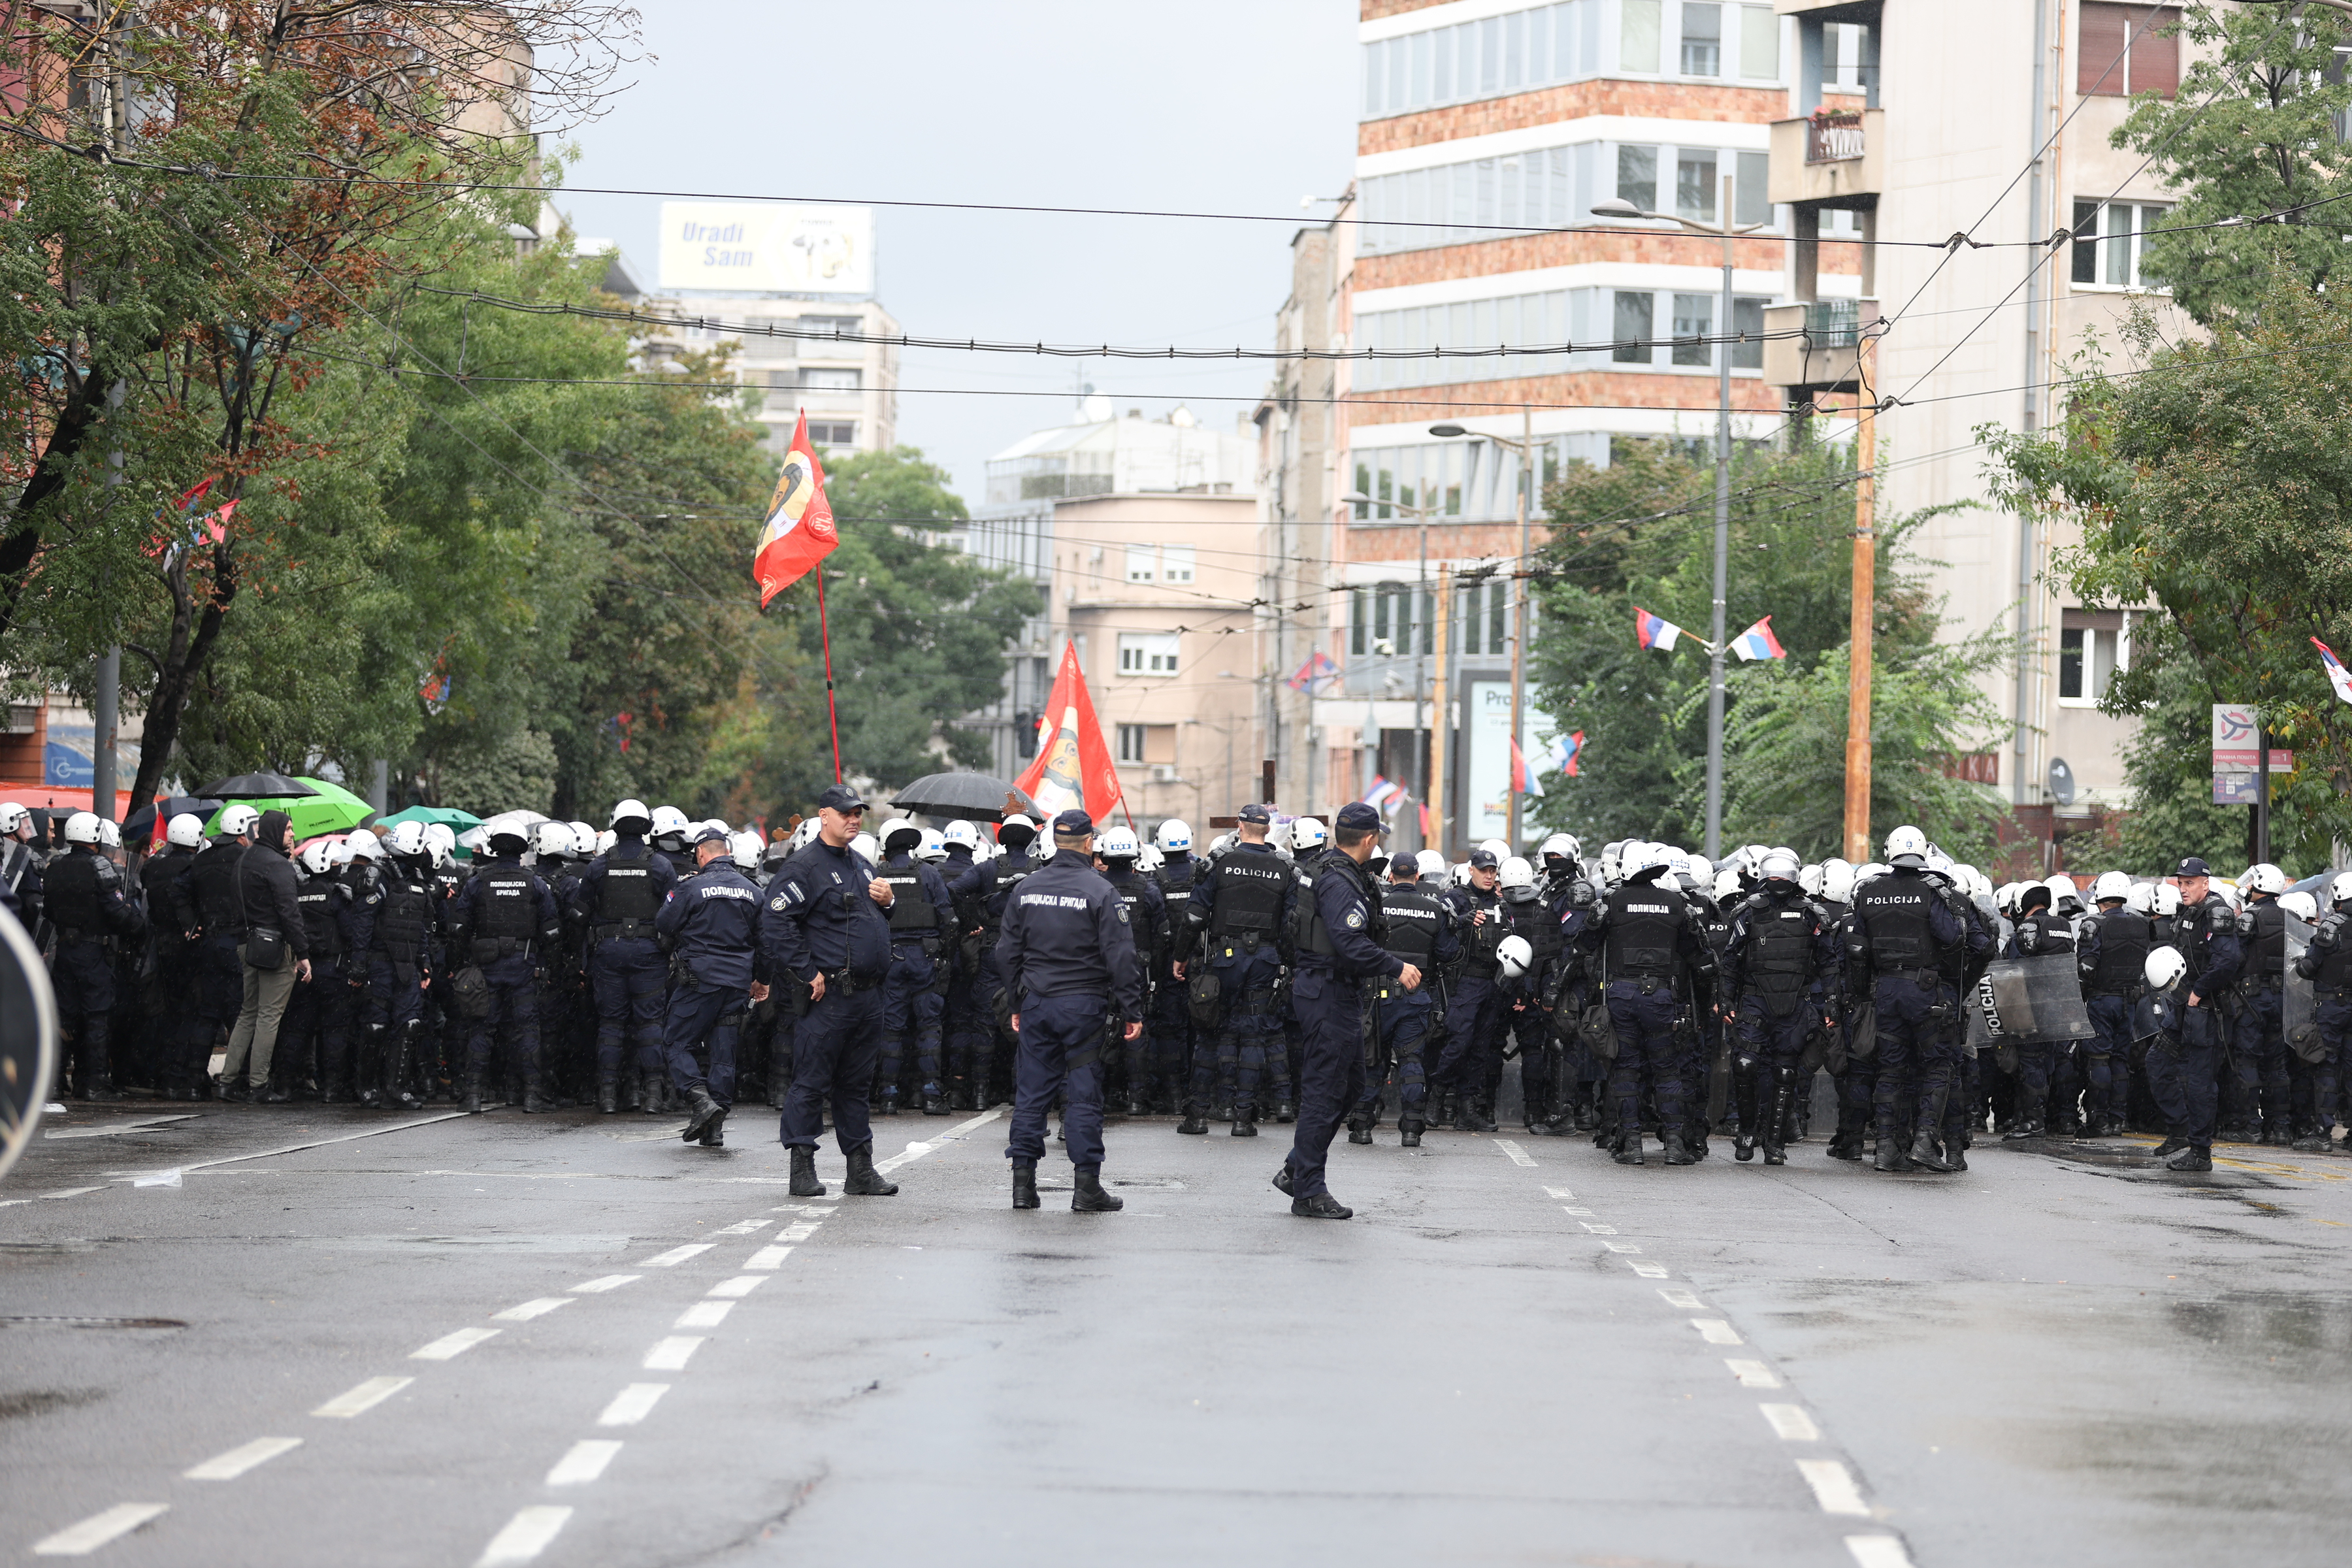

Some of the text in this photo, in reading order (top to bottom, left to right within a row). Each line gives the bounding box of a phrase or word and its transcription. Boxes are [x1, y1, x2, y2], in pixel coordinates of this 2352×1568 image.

[683, 222, 743, 242] Uradi
[704, 246, 754, 267] Sam
[2282, 753, 2287, 762] 1
[1225, 866, 1281, 880] POLICIJA
[701, 886, 755, 902] ПОЛИЦИЈА
[1867, 896, 1921, 905] POLICIJA
[1021, 894, 1087, 910] ПОЛИЦИЈСКА БРИГАДА
[1627, 904, 1669, 914] ПОЛИЦИЈА
[1382, 907, 1436, 919] ПОЛИЦИЈА
[1979, 974, 2005, 1036] POLICIJA
